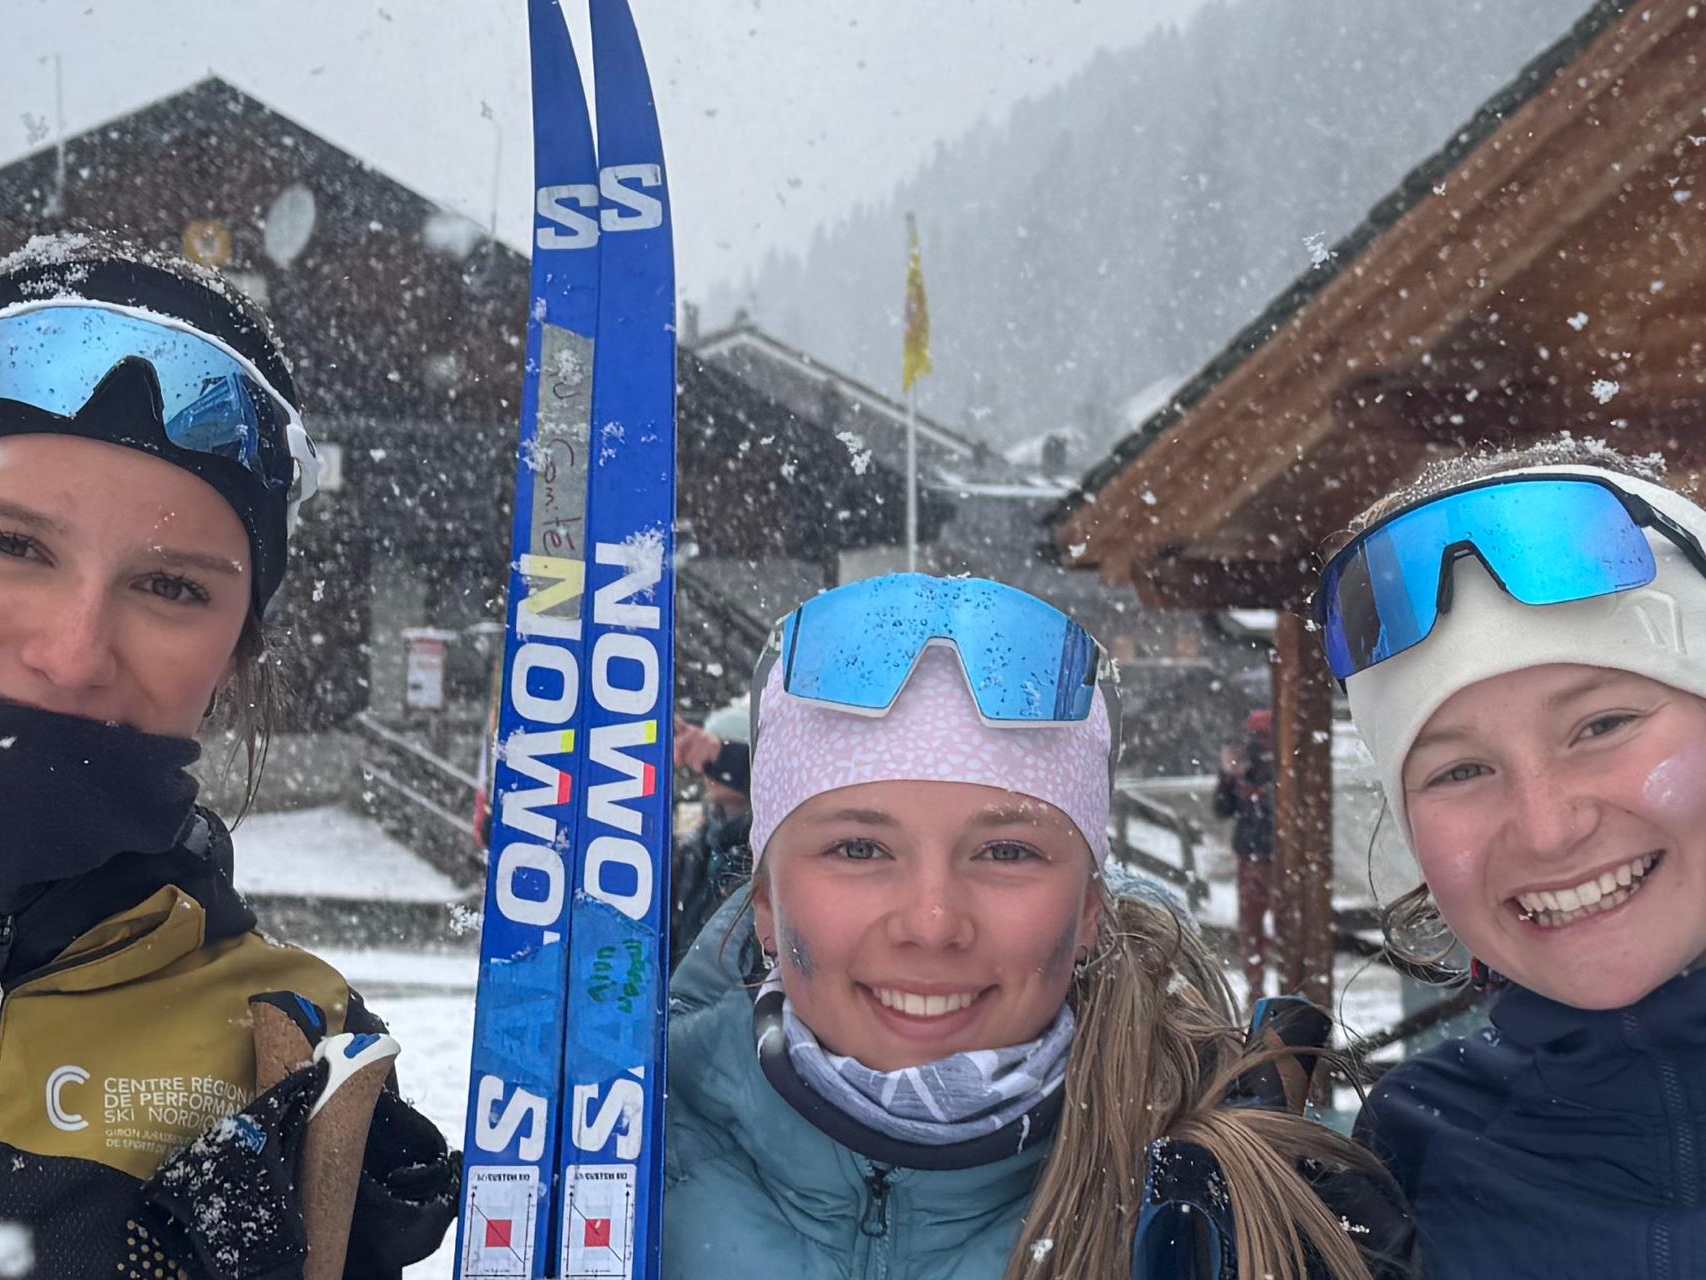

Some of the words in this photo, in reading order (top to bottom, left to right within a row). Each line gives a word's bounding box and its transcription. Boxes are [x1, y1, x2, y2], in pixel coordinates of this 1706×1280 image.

[105, 1076, 184, 1094] CENTRE
[105, 1093, 132, 1109] DE
[105, 1107, 134, 1123] SKI
